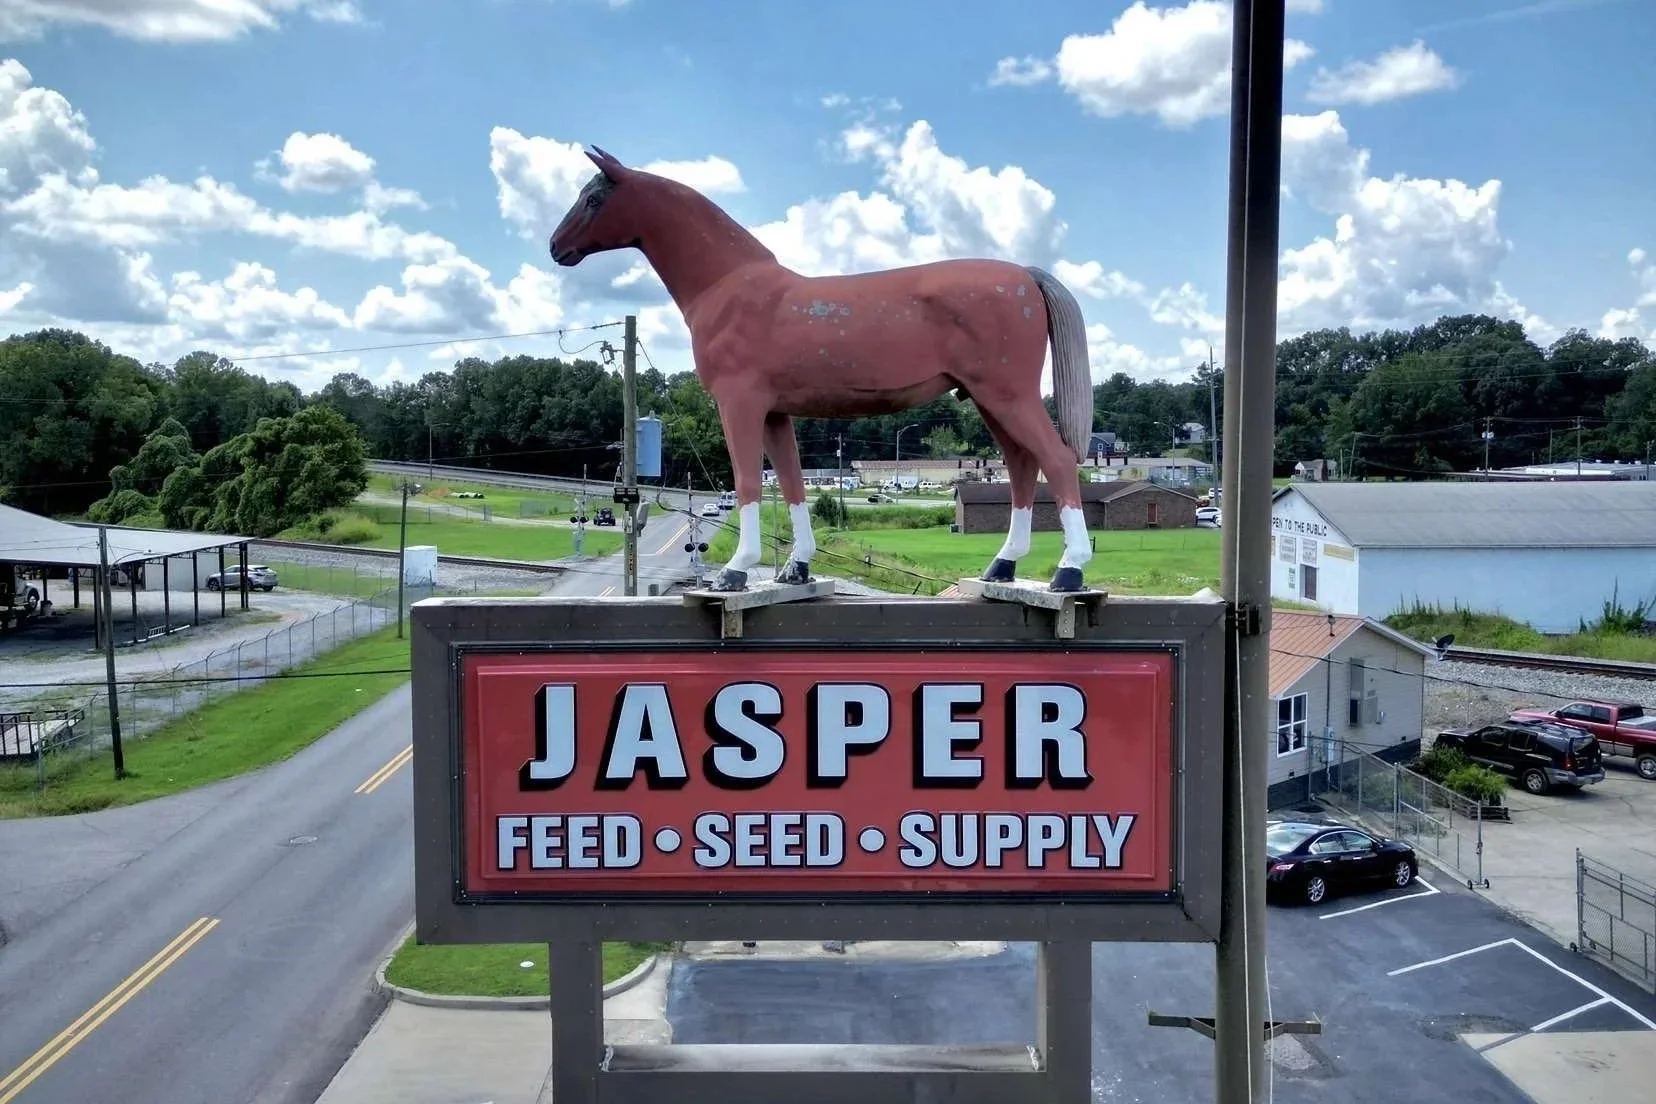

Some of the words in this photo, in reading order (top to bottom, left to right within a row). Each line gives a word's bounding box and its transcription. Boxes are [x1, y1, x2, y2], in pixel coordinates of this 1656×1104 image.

[1272, 516, 1283, 529] PEN
[1285, 519, 1292, 530] TO
[1294, 520, 1305, 533] THE
[1306, 522, 1328, 537] PUBLIC
[520, 682, 1093, 790] JASPER
[497, 813, 642, 869] FEED
[693, 811, 844, 869] SEED
[899, 811, 1136, 869] SUPPLY
